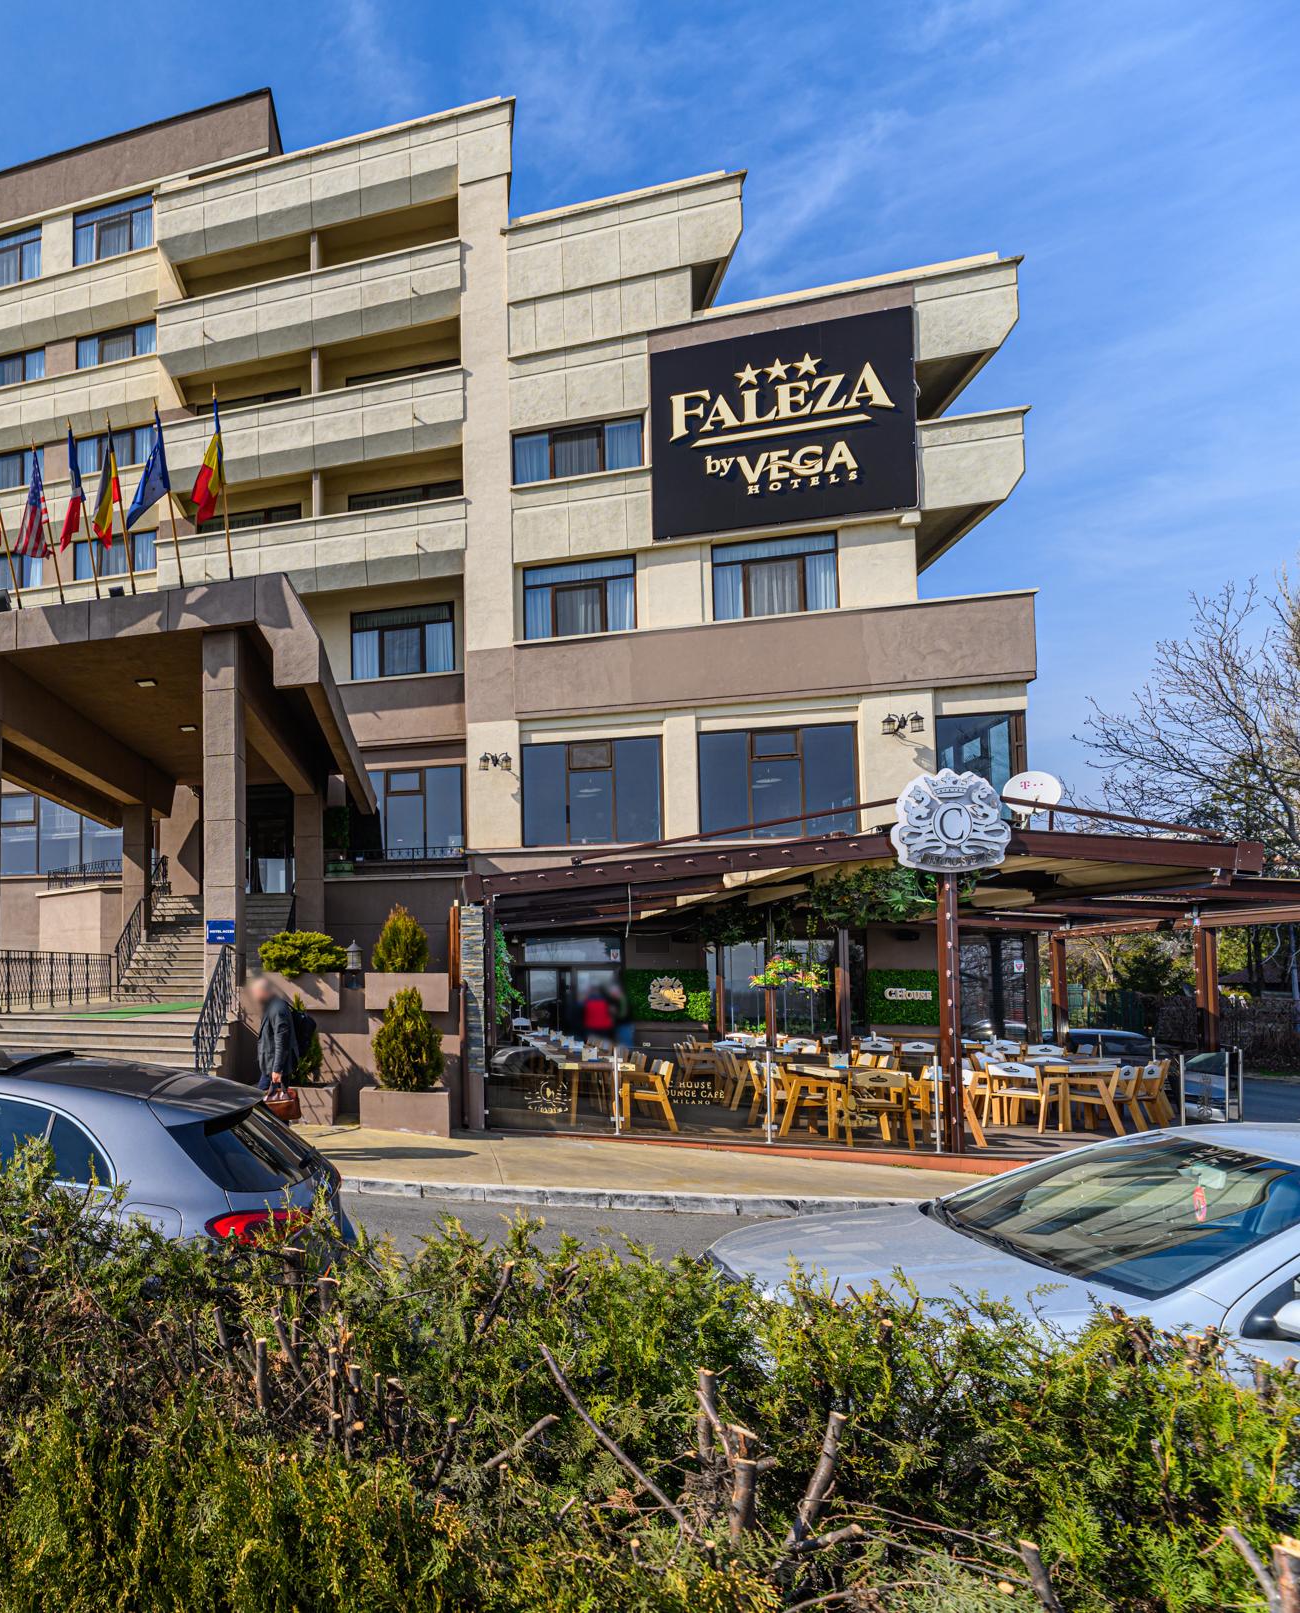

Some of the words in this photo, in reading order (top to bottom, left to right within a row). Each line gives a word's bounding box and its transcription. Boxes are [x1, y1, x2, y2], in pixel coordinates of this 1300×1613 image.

[669, 361, 895, 443] FALEZA
[705, 454, 735, 478] by
[736, 440, 859, 484] VEGA
[747, 470, 859, 496] HOTELS
[939, 807, 965, 840] C
[666, 1089, 697, 1098] OUNGE
[679, 1081, 712, 1090] HOUSE
[672, 1098, 711, 1106] MILANO
